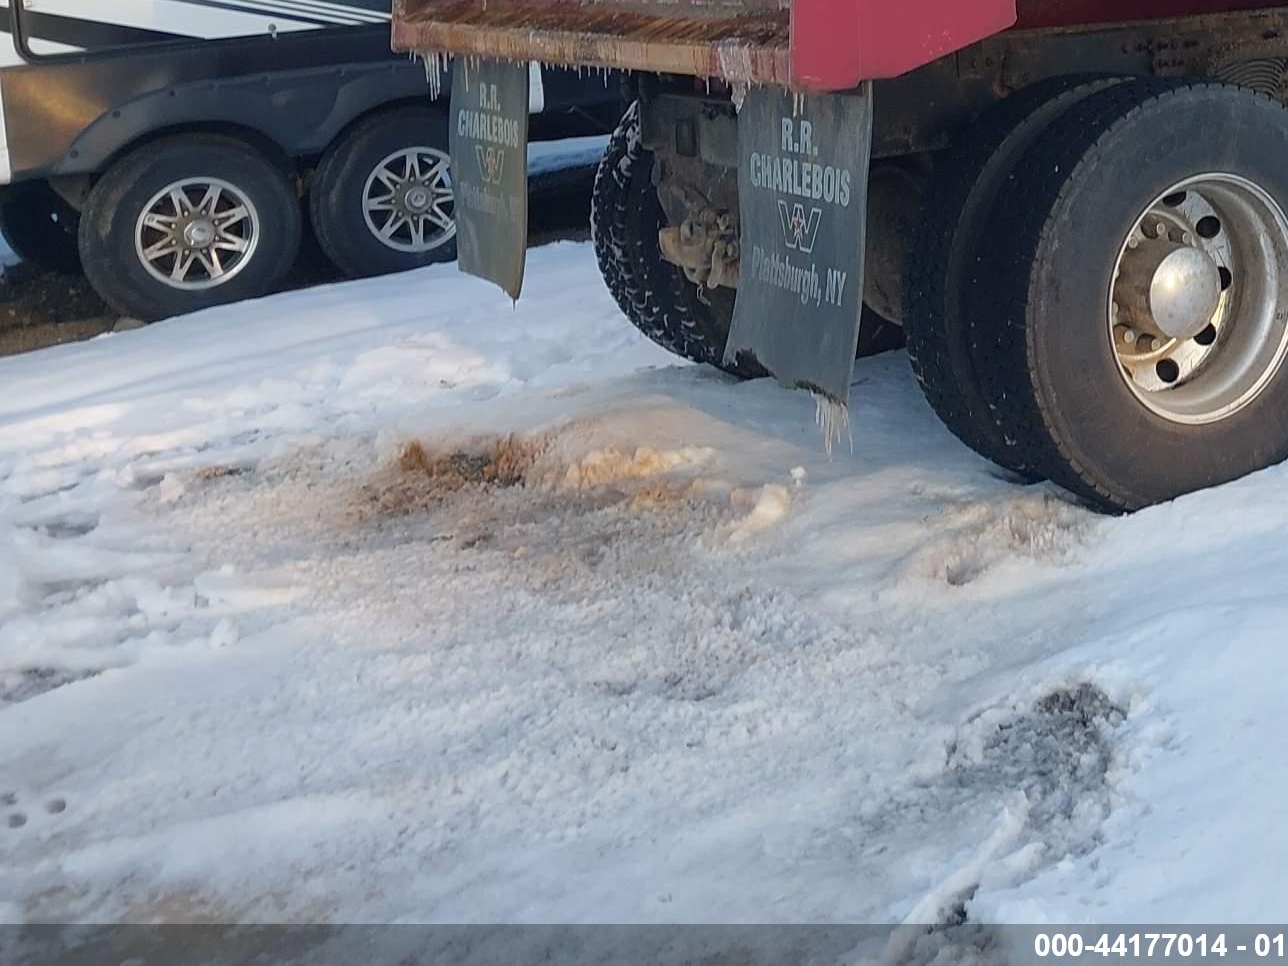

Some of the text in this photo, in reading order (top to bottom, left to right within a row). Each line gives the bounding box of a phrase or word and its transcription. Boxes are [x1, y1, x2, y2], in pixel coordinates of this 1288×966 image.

[457, 109, 520, 149] CHARLEBOIS
[781, 117, 819, 156] R.R.
[750, 151, 851, 207] CHARLEBOIS
[825, 267, 847, 306] NY
